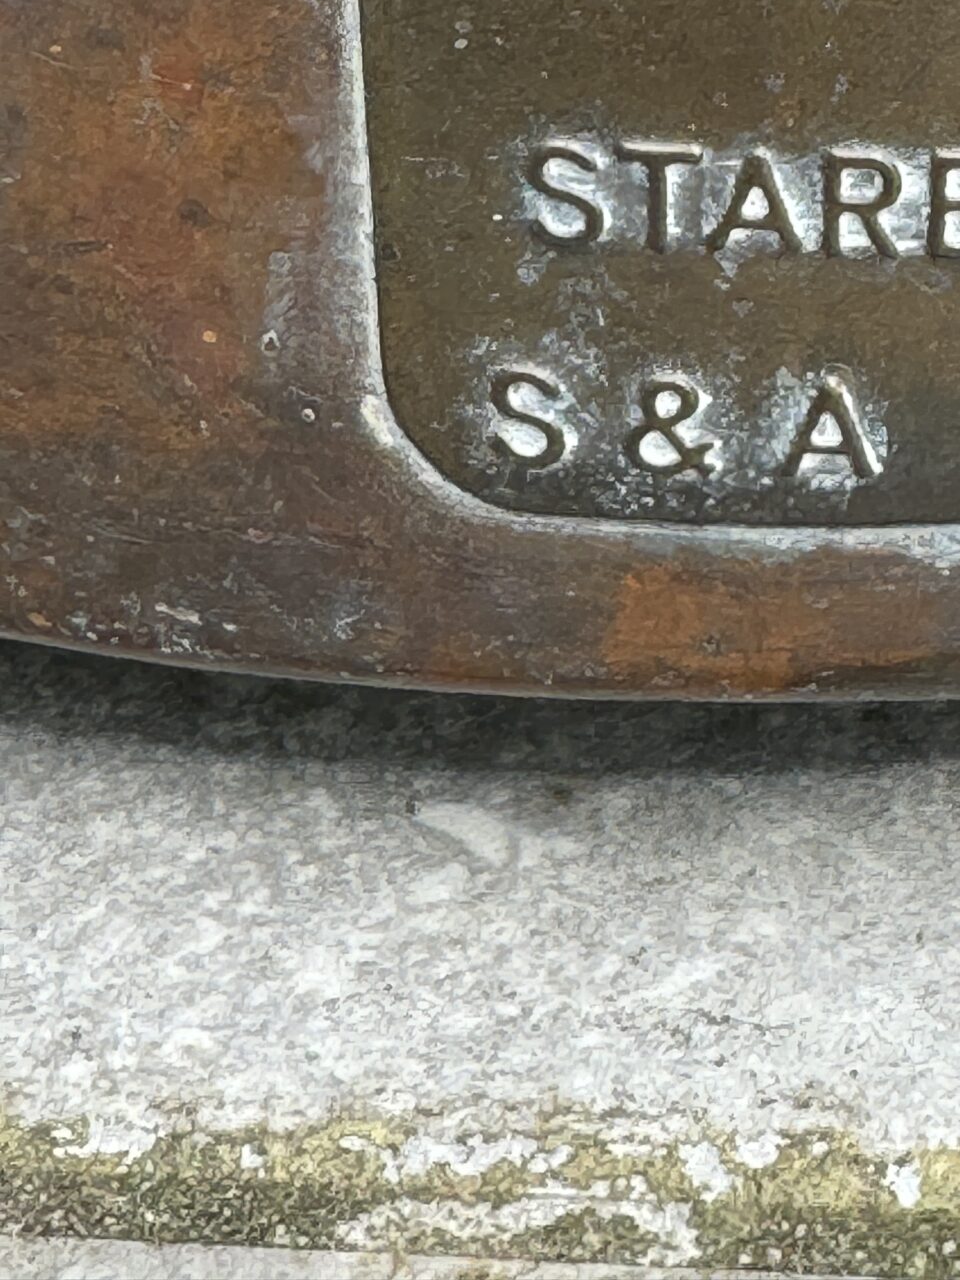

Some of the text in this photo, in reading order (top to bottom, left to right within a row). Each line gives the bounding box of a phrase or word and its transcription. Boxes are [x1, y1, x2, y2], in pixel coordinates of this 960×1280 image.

[490, 366, 582, 464] S
[624, 376, 722, 476] &
[780, 370, 886, 478] A
